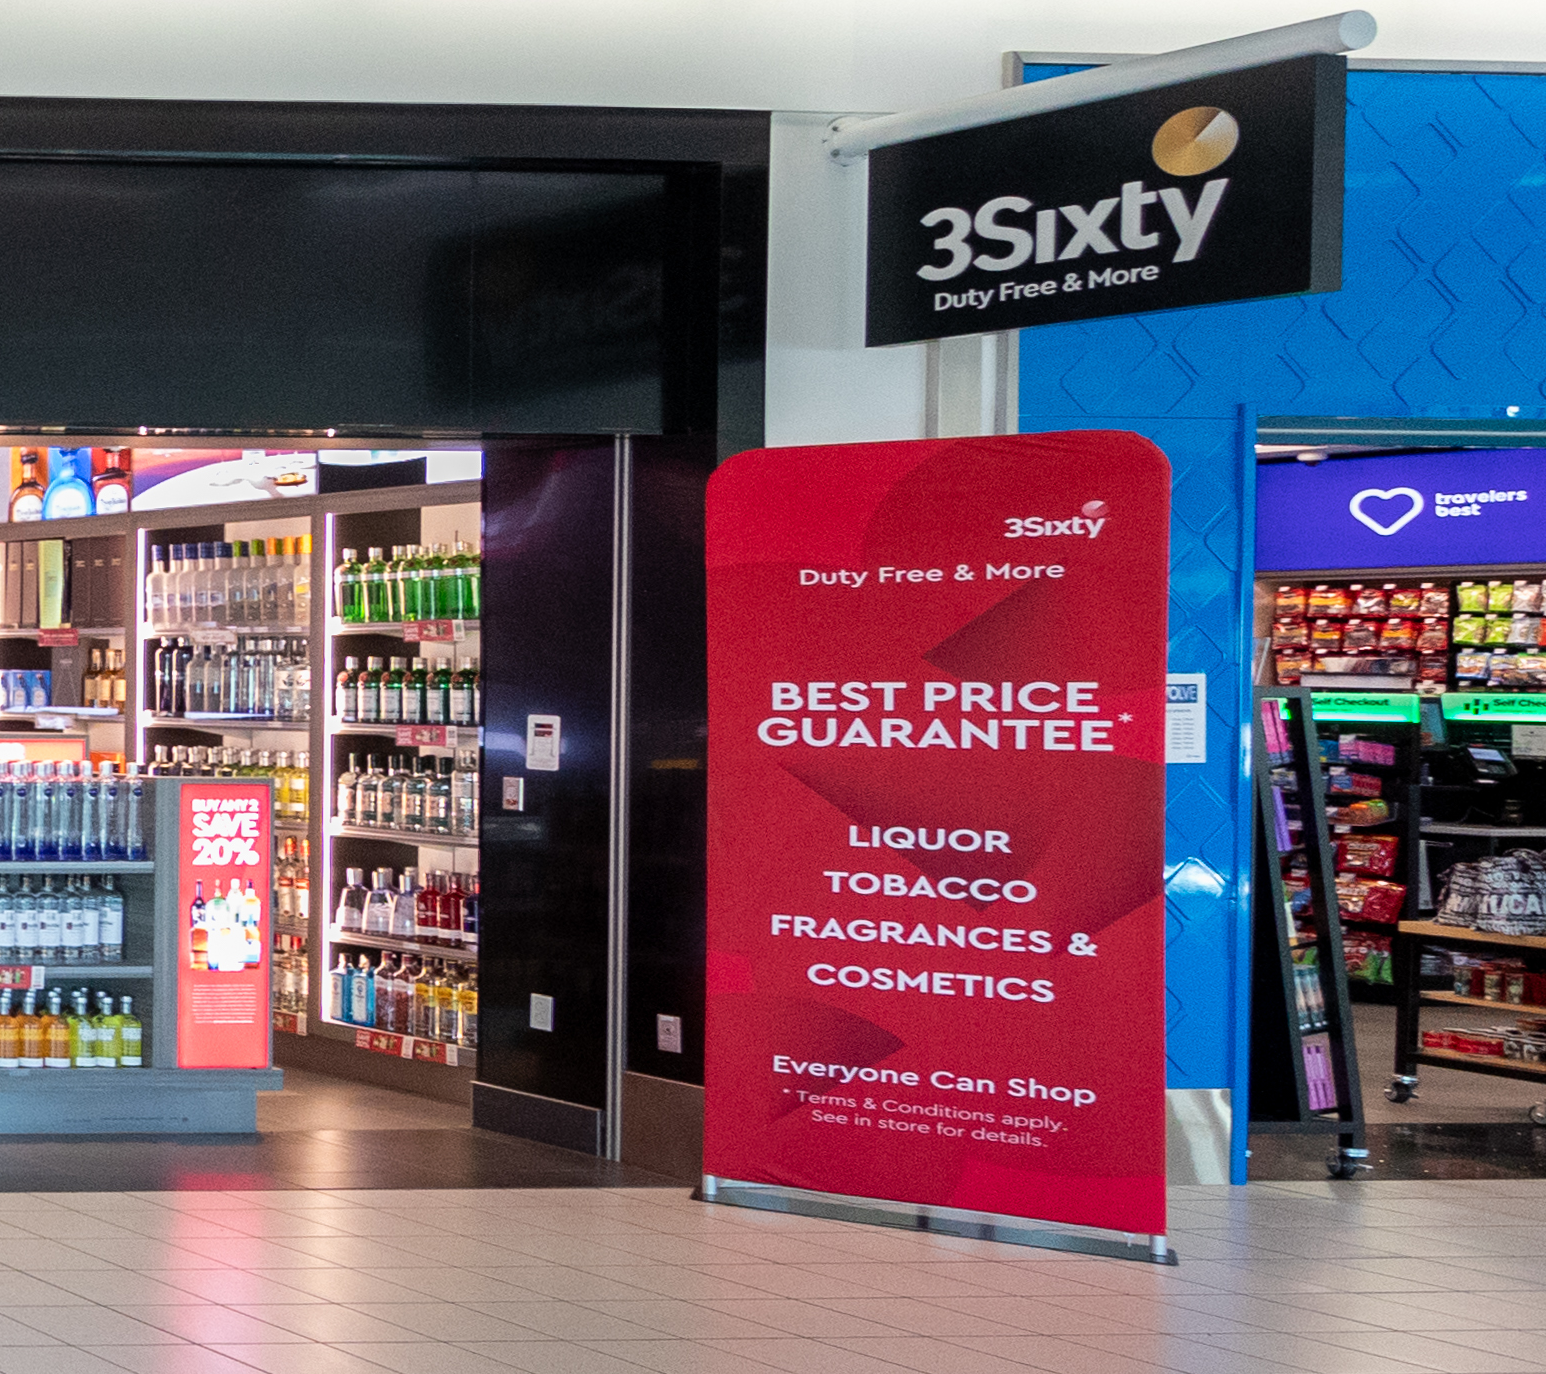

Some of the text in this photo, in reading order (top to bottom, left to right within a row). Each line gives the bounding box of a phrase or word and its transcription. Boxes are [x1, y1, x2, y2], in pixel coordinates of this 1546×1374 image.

[916, 177, 1230, 282] 3Sixty
[933, 265, 1160, 312] Duty Free & More
[1435, 489, 1528, 505] travelers
[1435, 503, 1482, 518] best
[1003, 515, 1106, 539] 3Sixty
[799, 562, 1065, 588] Duty Free & More
[771, 681, 1100, 713] BEST PRICE
[1332, 698, 1390, 707] Checkout
[1493, 698, 1516, 708] Self
[192, 799, 260, 812] BUY ANY 2
[191, 812, 260, 838] SAVE
[848, 824, 1013, 855] LIQUOR
[191, 838, 260, 866] 20%
[822, 869, 1038, 904] TOBACCO
[770, 913, 1099, 957] FRAGRANCES &
[806, 962, 1056, 1004] COSMETICS
[772, 1054, 1098, 1108] Everyone Can Shop
[795, 1089, 1070, 1133] Terms & Conditions apply.
[811, 1109, 1050, 1149] See in store for details.
